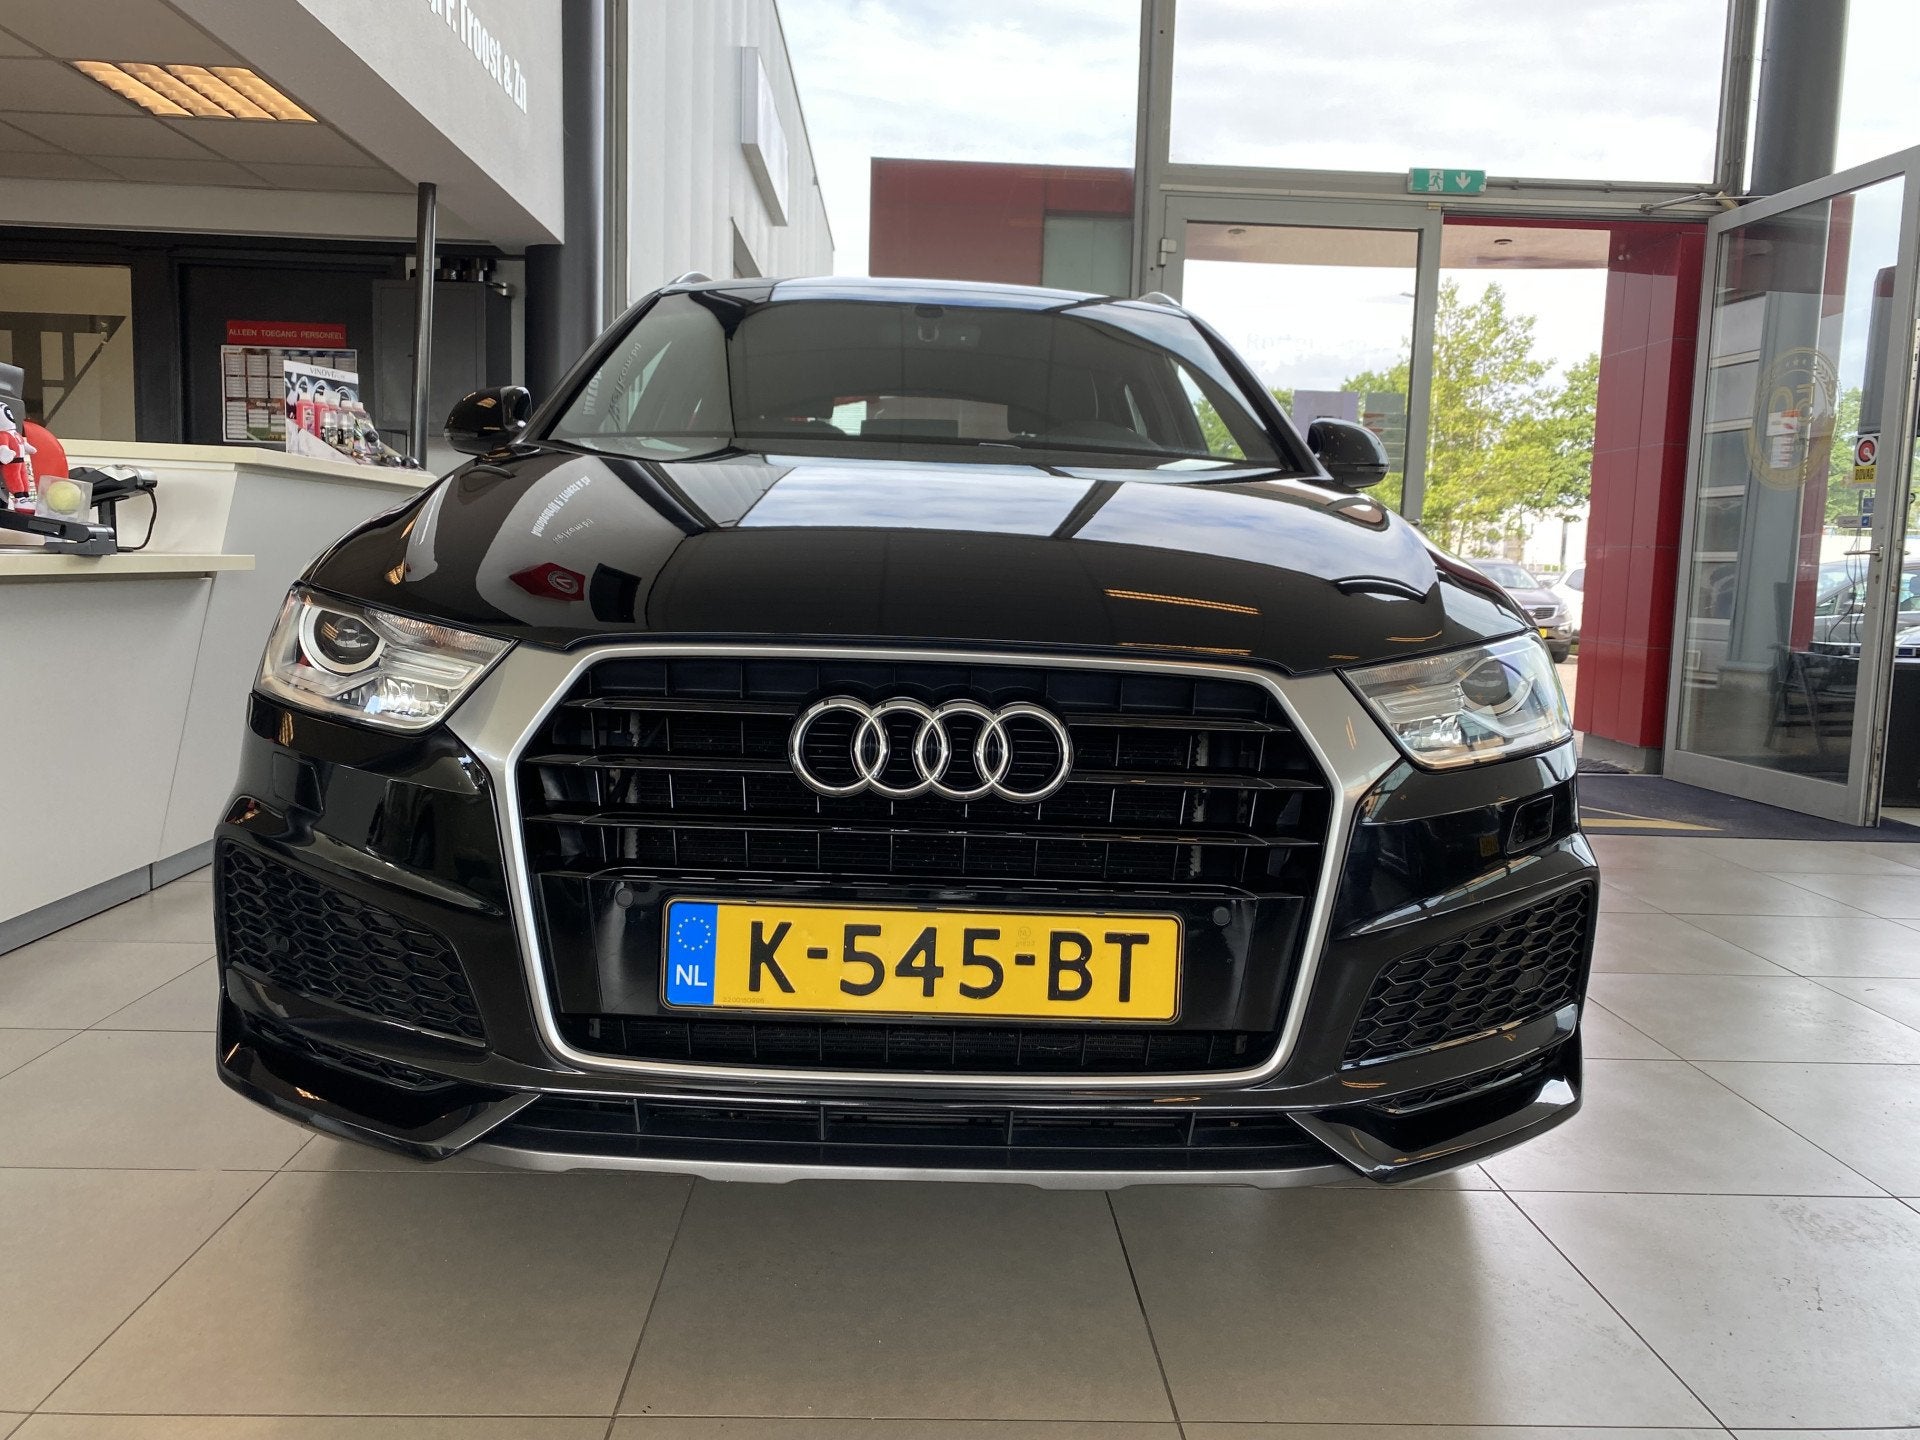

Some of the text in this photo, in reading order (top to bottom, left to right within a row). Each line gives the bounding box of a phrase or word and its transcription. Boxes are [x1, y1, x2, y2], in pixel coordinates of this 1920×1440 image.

[460, 0, 502, 86] Troost
[503, 54, 513, 98] &
[513, 59, 527, 115] Zn
[228, 328, 344, 340] ALLEEN TOEGANG PERSONEEL
[675, 964, 708, 987] NL
[747, 920, 1150, 1003] K-545-BT
